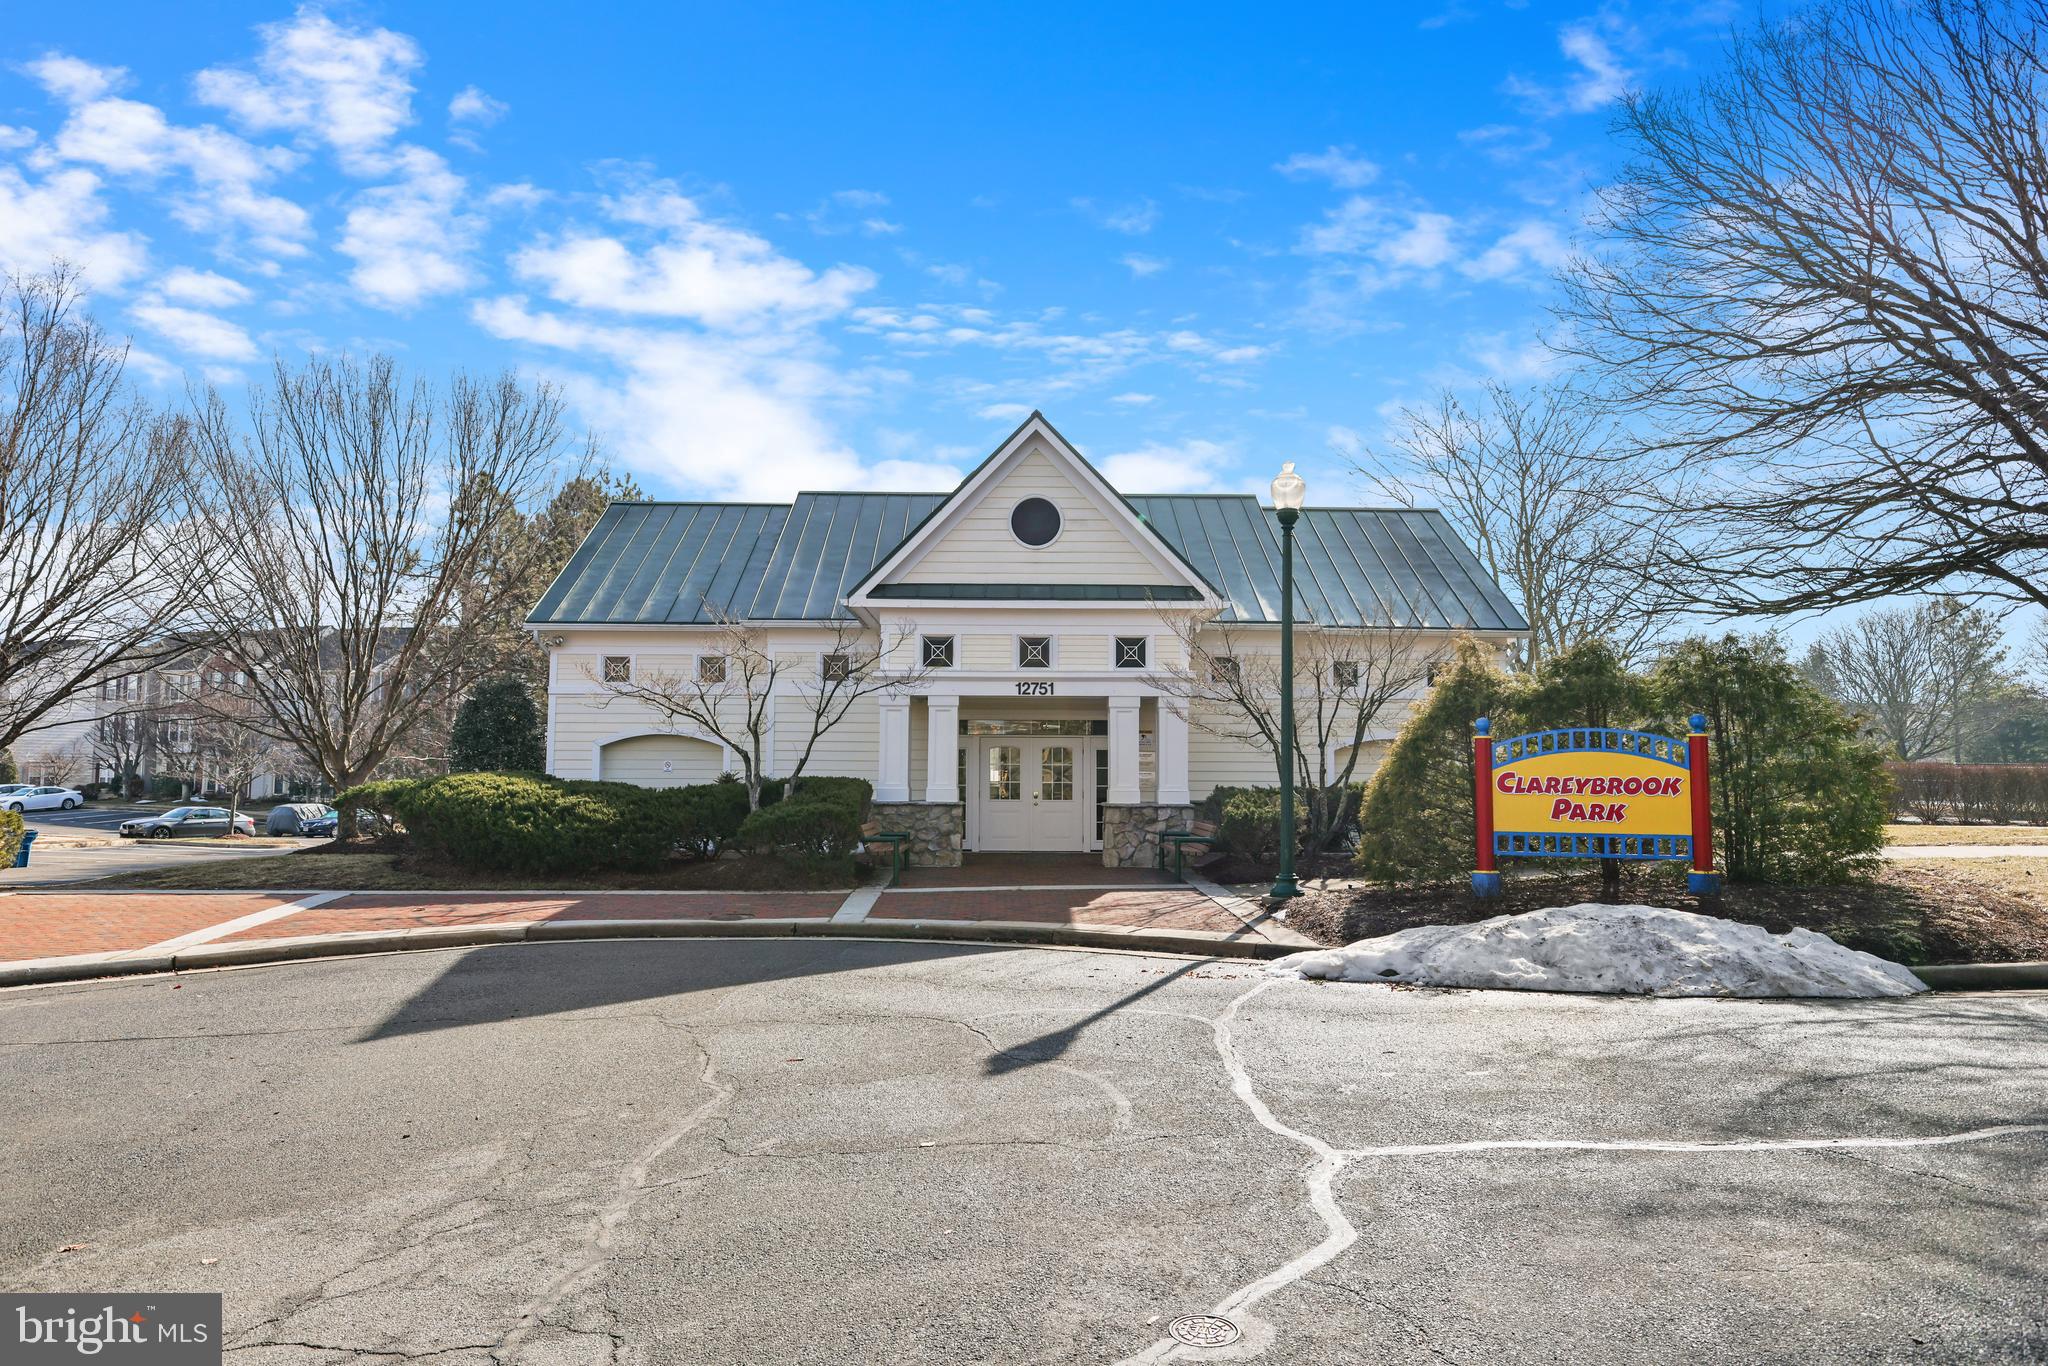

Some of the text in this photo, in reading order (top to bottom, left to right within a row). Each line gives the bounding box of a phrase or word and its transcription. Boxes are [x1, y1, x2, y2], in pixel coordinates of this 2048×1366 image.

[1015, 682, 1054, 695] 12751
[1496, 771, 1685, 797] CLAREYBROOK
[1550, 798, 1628, 823] PARK
